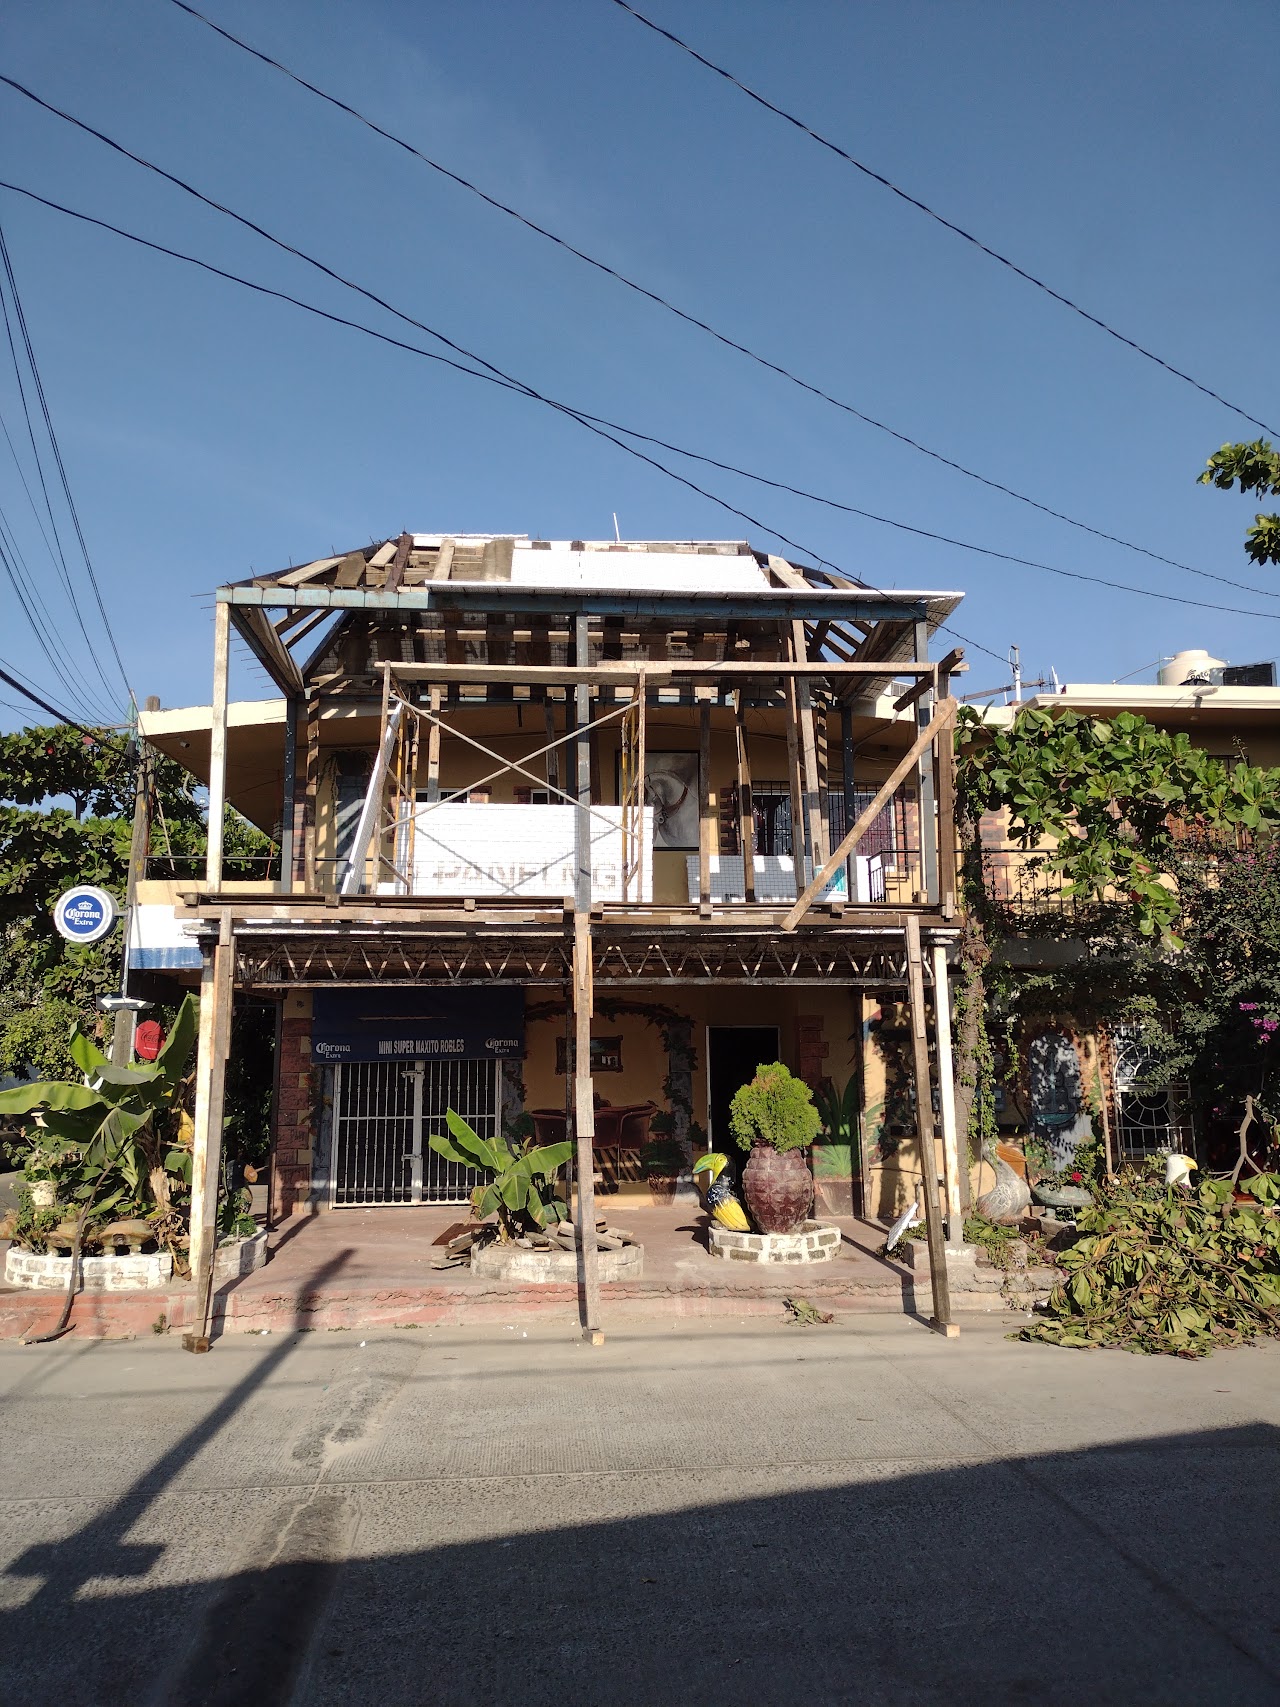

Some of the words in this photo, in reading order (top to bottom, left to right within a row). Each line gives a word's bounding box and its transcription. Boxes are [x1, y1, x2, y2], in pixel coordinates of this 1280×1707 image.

[65, 908, 101, 920] Corona
[74, 918, 93, 926] Extra
[315, 1042, 351, 1054] Corona
[378, 1041, 393, 1055] MINI
[393, 1040, 415, 1054] SUPER
[415, 1040, 439, 1054] MAXITO
[440, 1039, 465, 1053] ROBLES
[485, 1038, 519, 1049] Corona
